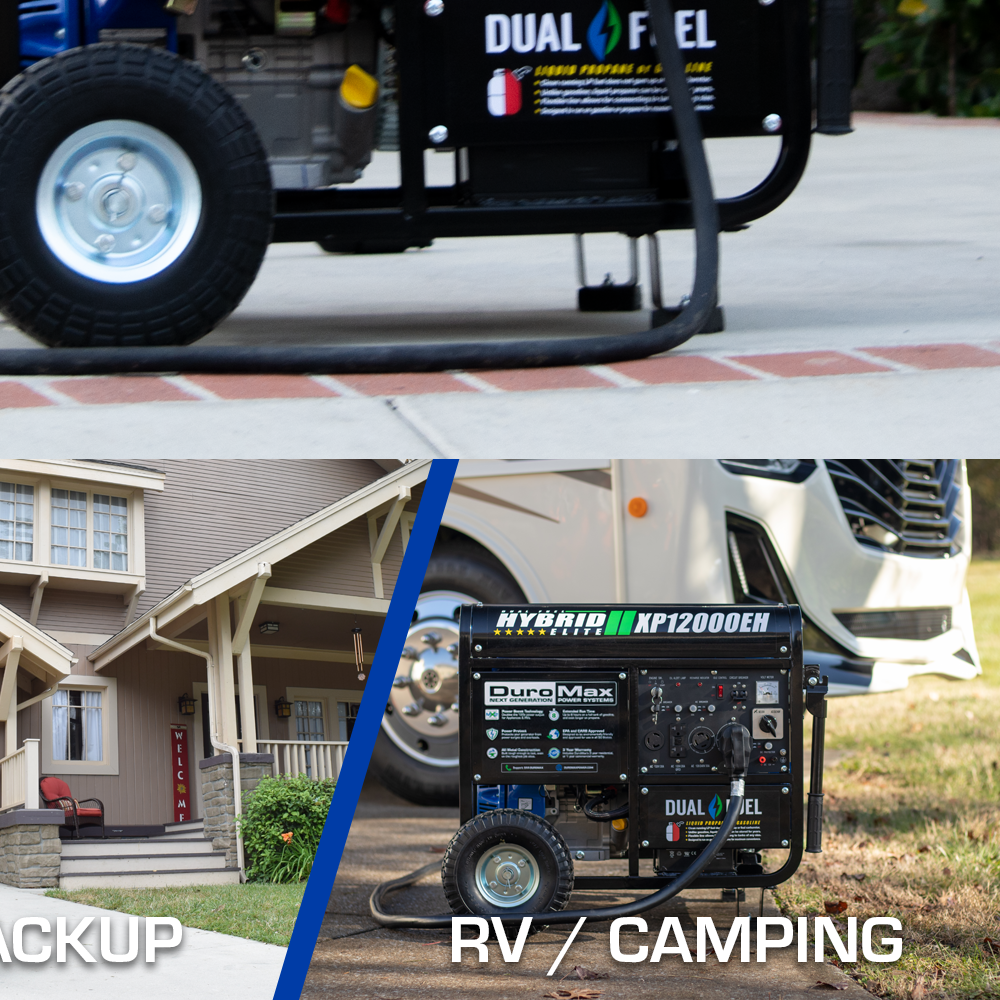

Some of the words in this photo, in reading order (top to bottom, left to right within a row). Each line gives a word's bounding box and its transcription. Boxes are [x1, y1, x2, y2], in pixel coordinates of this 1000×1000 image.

[485, 12, 582, 53] DUAL
[628, 9, 716, 50] FEL
[496, 613, 606, 627] HYBRID
[634, 612, 770, 633] XP12000EH
[550, 628, 602, 636] ELITE
[665, 799, 705, 816] DUAL
